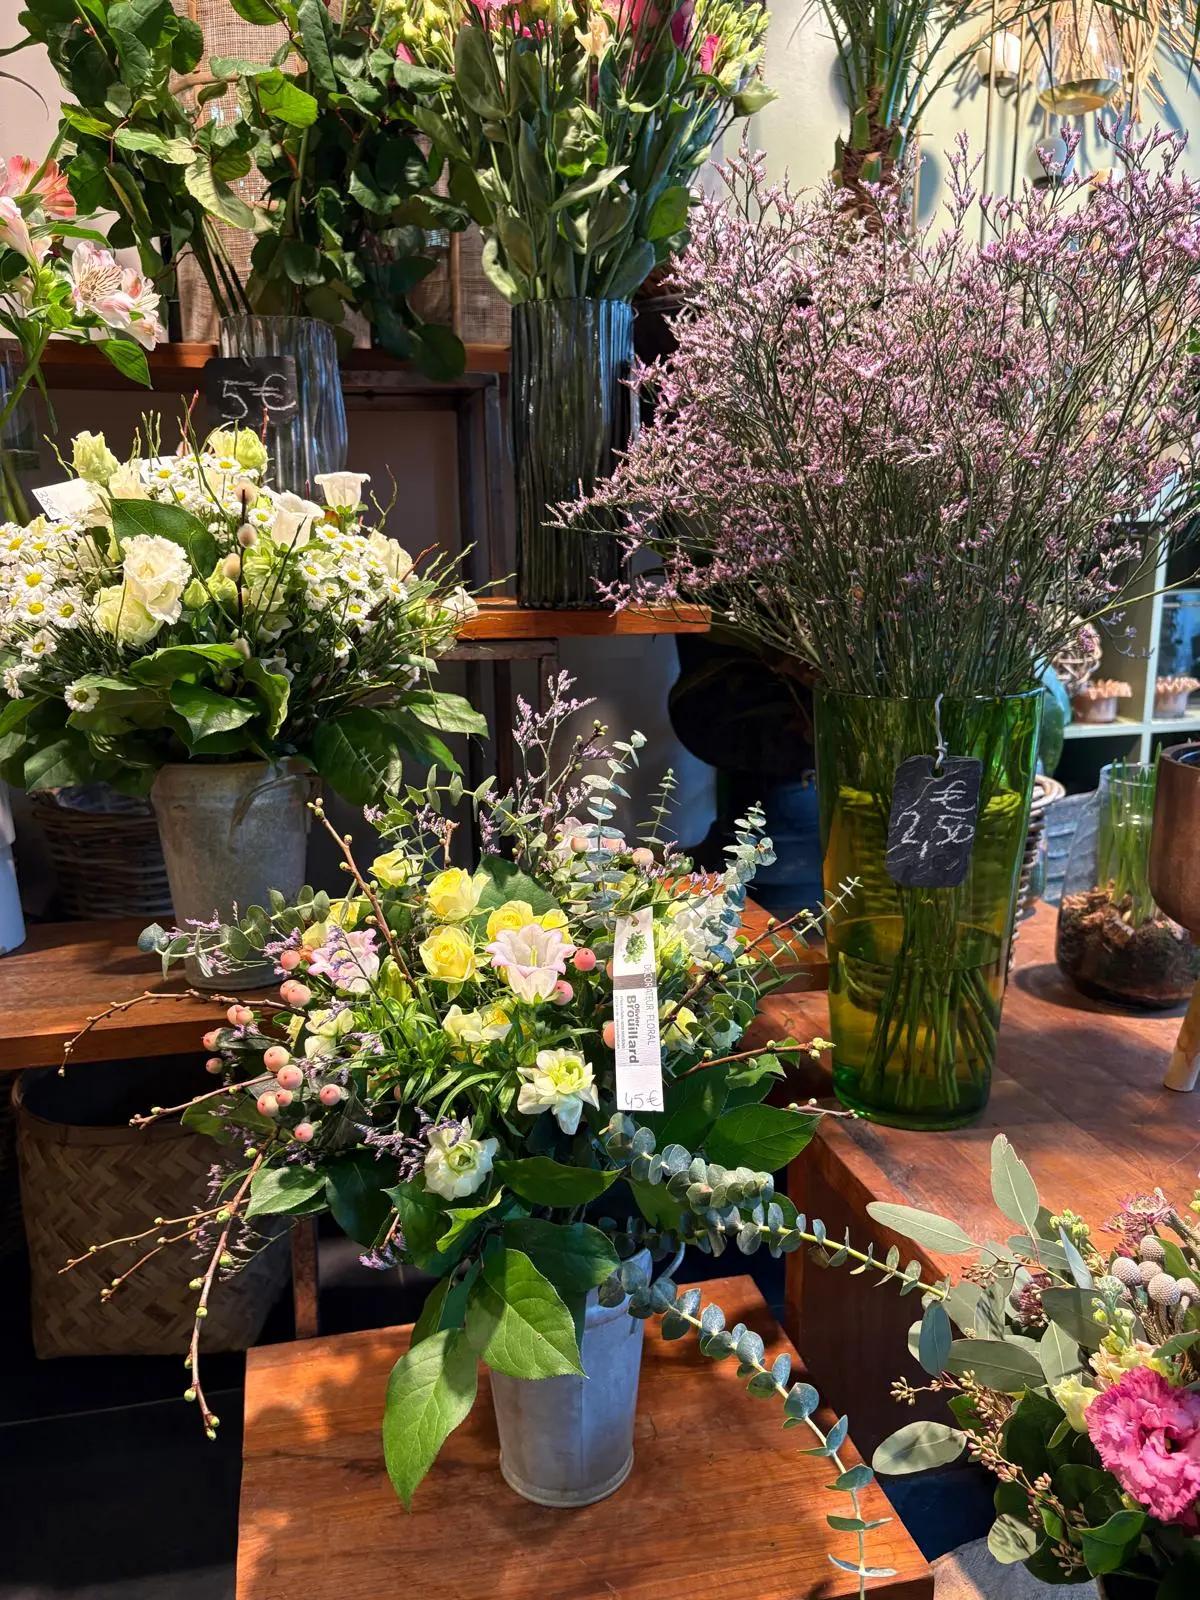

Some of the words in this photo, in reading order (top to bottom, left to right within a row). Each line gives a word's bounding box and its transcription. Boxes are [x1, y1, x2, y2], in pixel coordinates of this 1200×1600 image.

[220, 373, 297, 419] 5€
[930, 780, 976, 813] €
[896, 810, 975, 860] 2,50
[626, 995, 639, 1064] Brouillard
[646, 1014, 656, 1046] FLORAL
[624, 1089, 662, 1110] 45€
